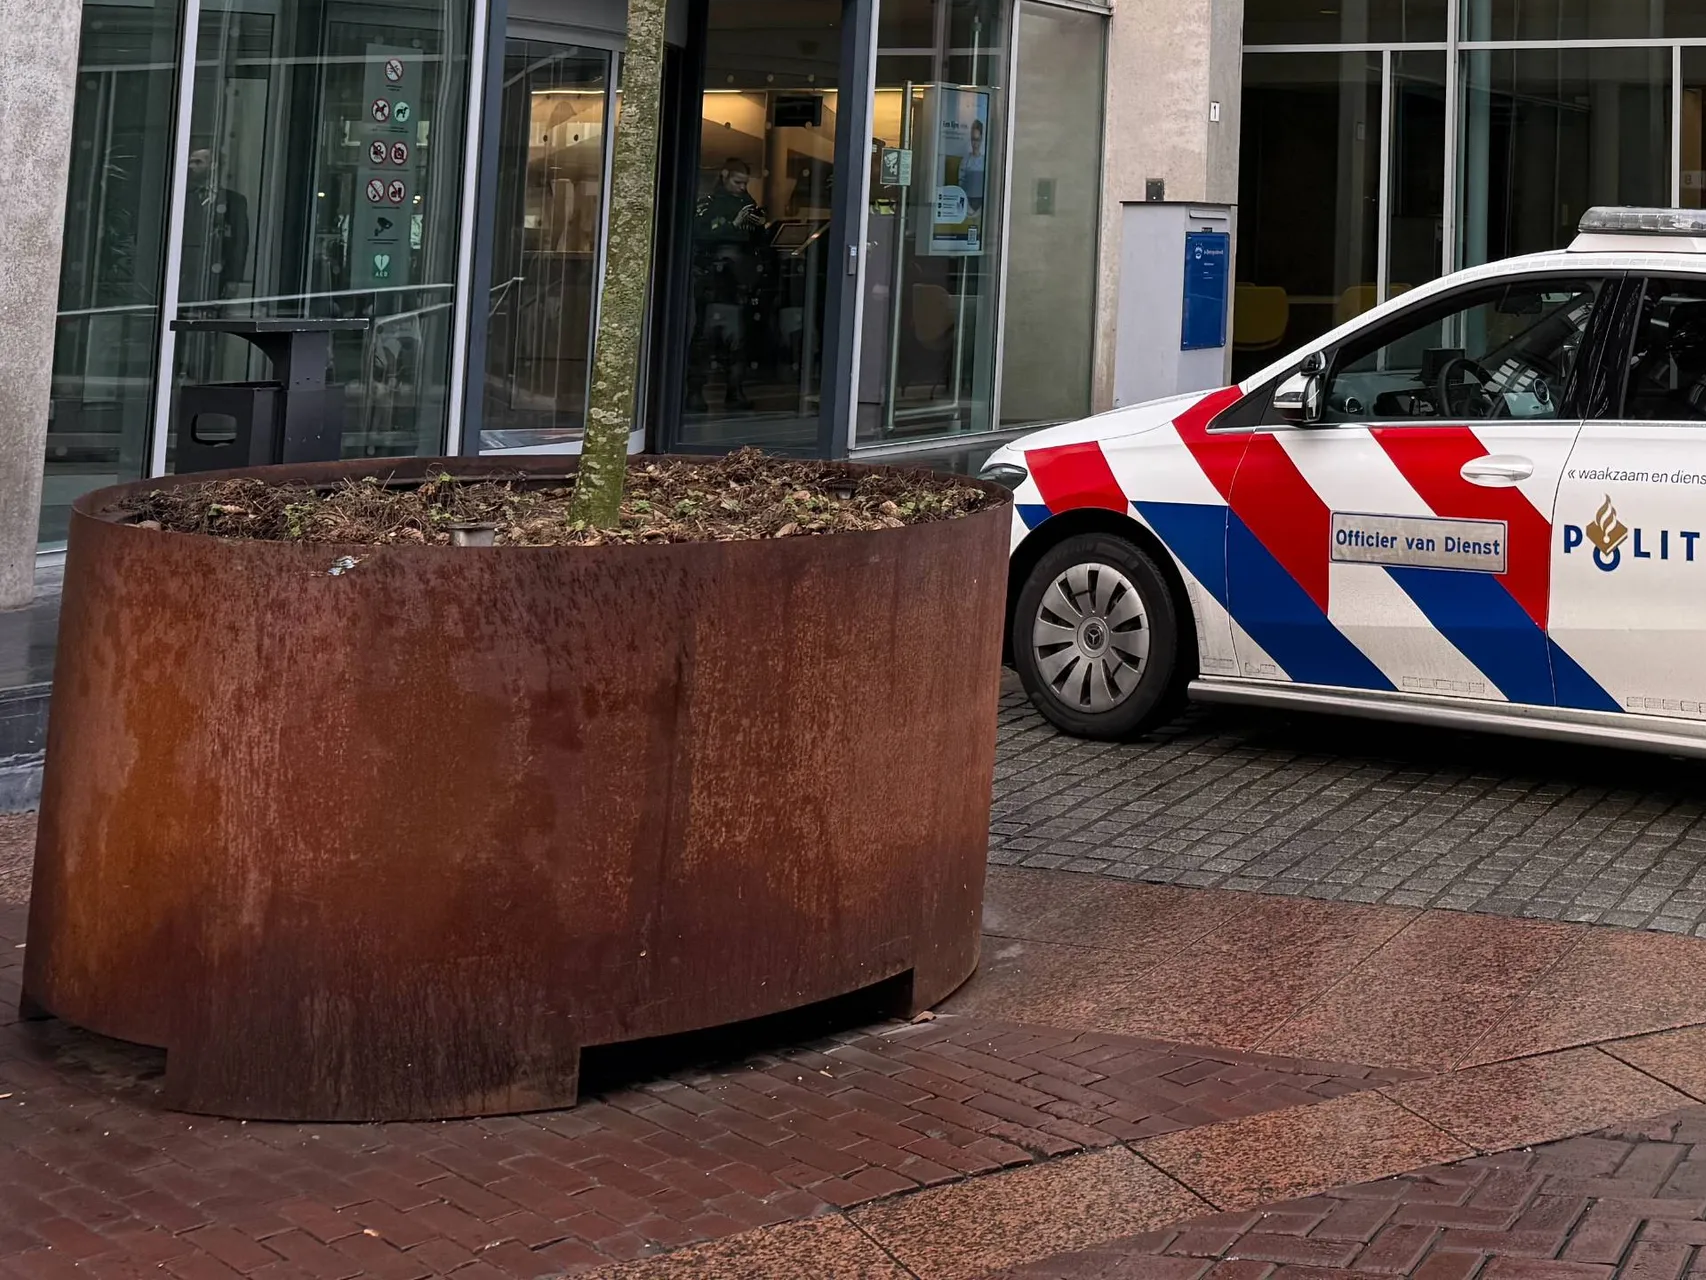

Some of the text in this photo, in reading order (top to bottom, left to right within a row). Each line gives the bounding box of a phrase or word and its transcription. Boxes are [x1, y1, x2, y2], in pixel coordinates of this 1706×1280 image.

[1578, 466, 1649, 482] waakzaam
[1651, 471, 1668, 483] en
[1335, 528, 1501, 556] Officier van Dienst
